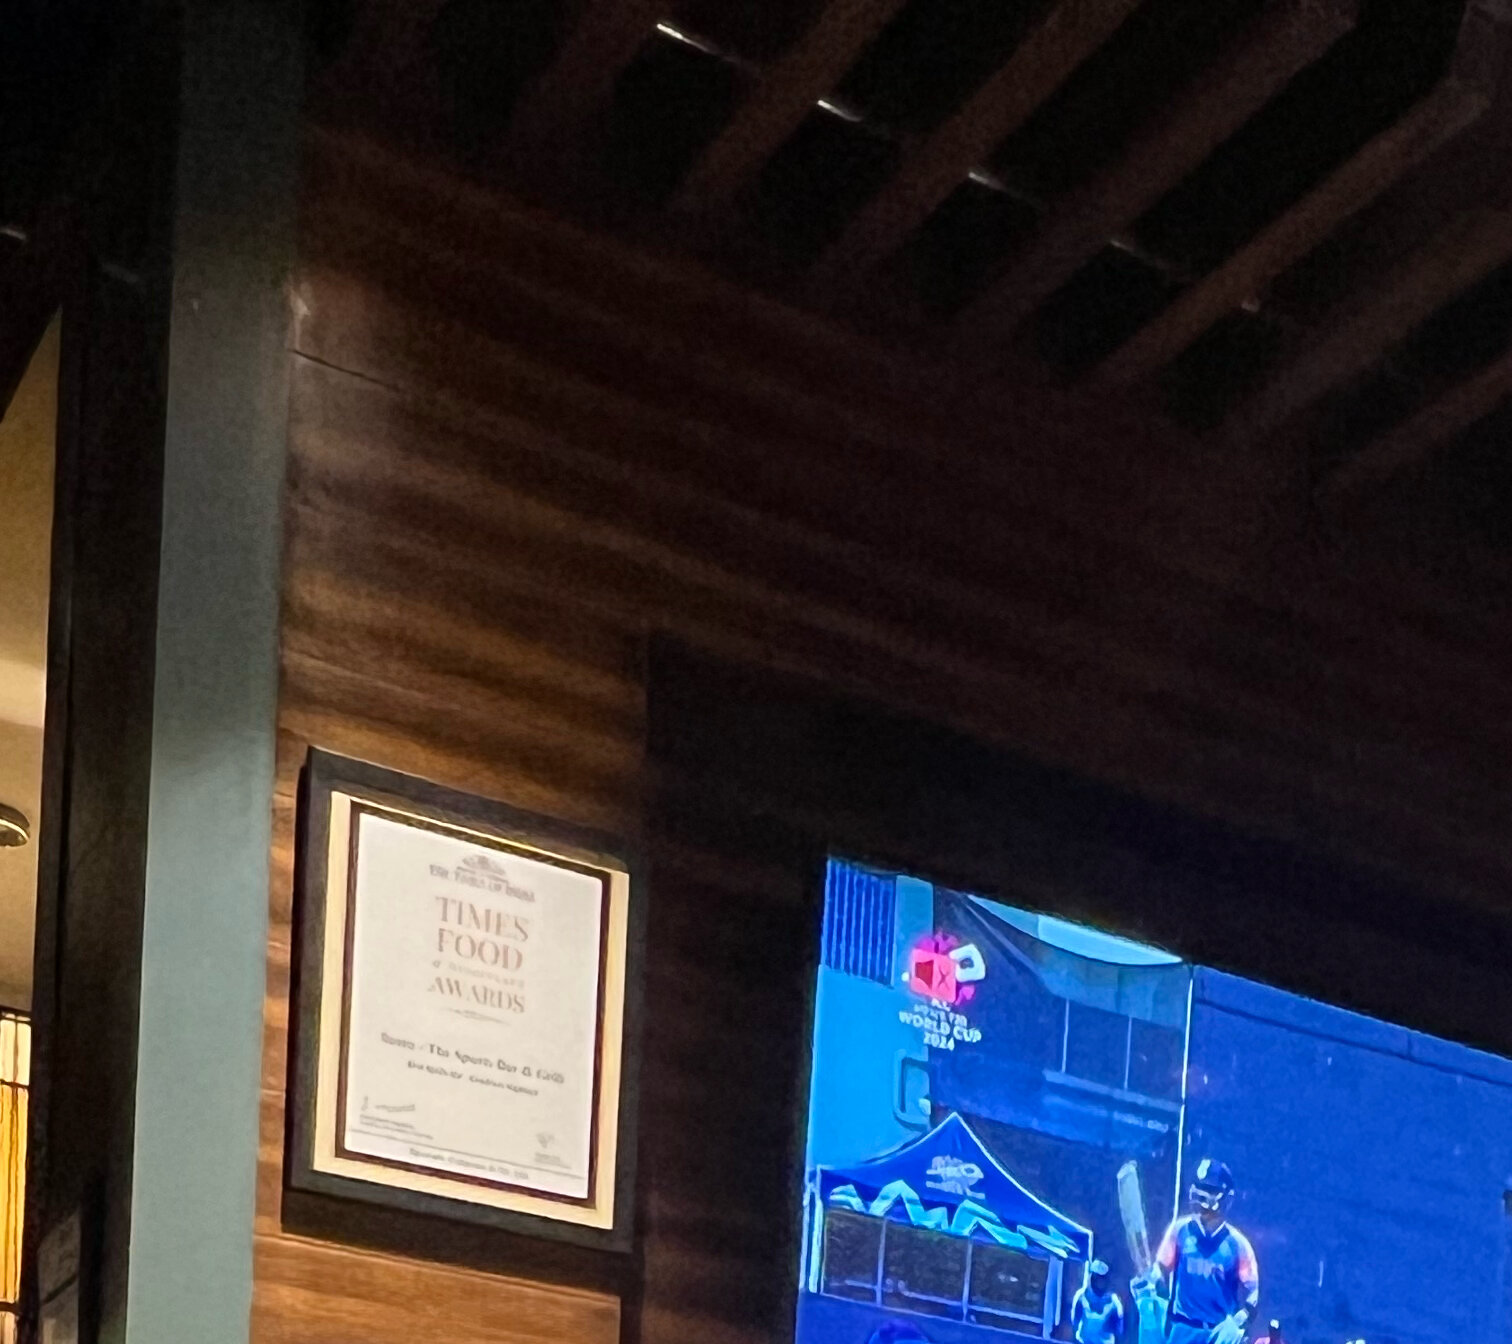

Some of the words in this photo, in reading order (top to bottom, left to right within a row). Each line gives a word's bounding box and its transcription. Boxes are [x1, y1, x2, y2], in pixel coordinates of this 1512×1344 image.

[435, 896, 529, 942] TIMES
[438, 927, 523, 971] FOOD
[428, 976, 525, 1013] AWARDS
[953, 1026, 982, 1043] CUP
